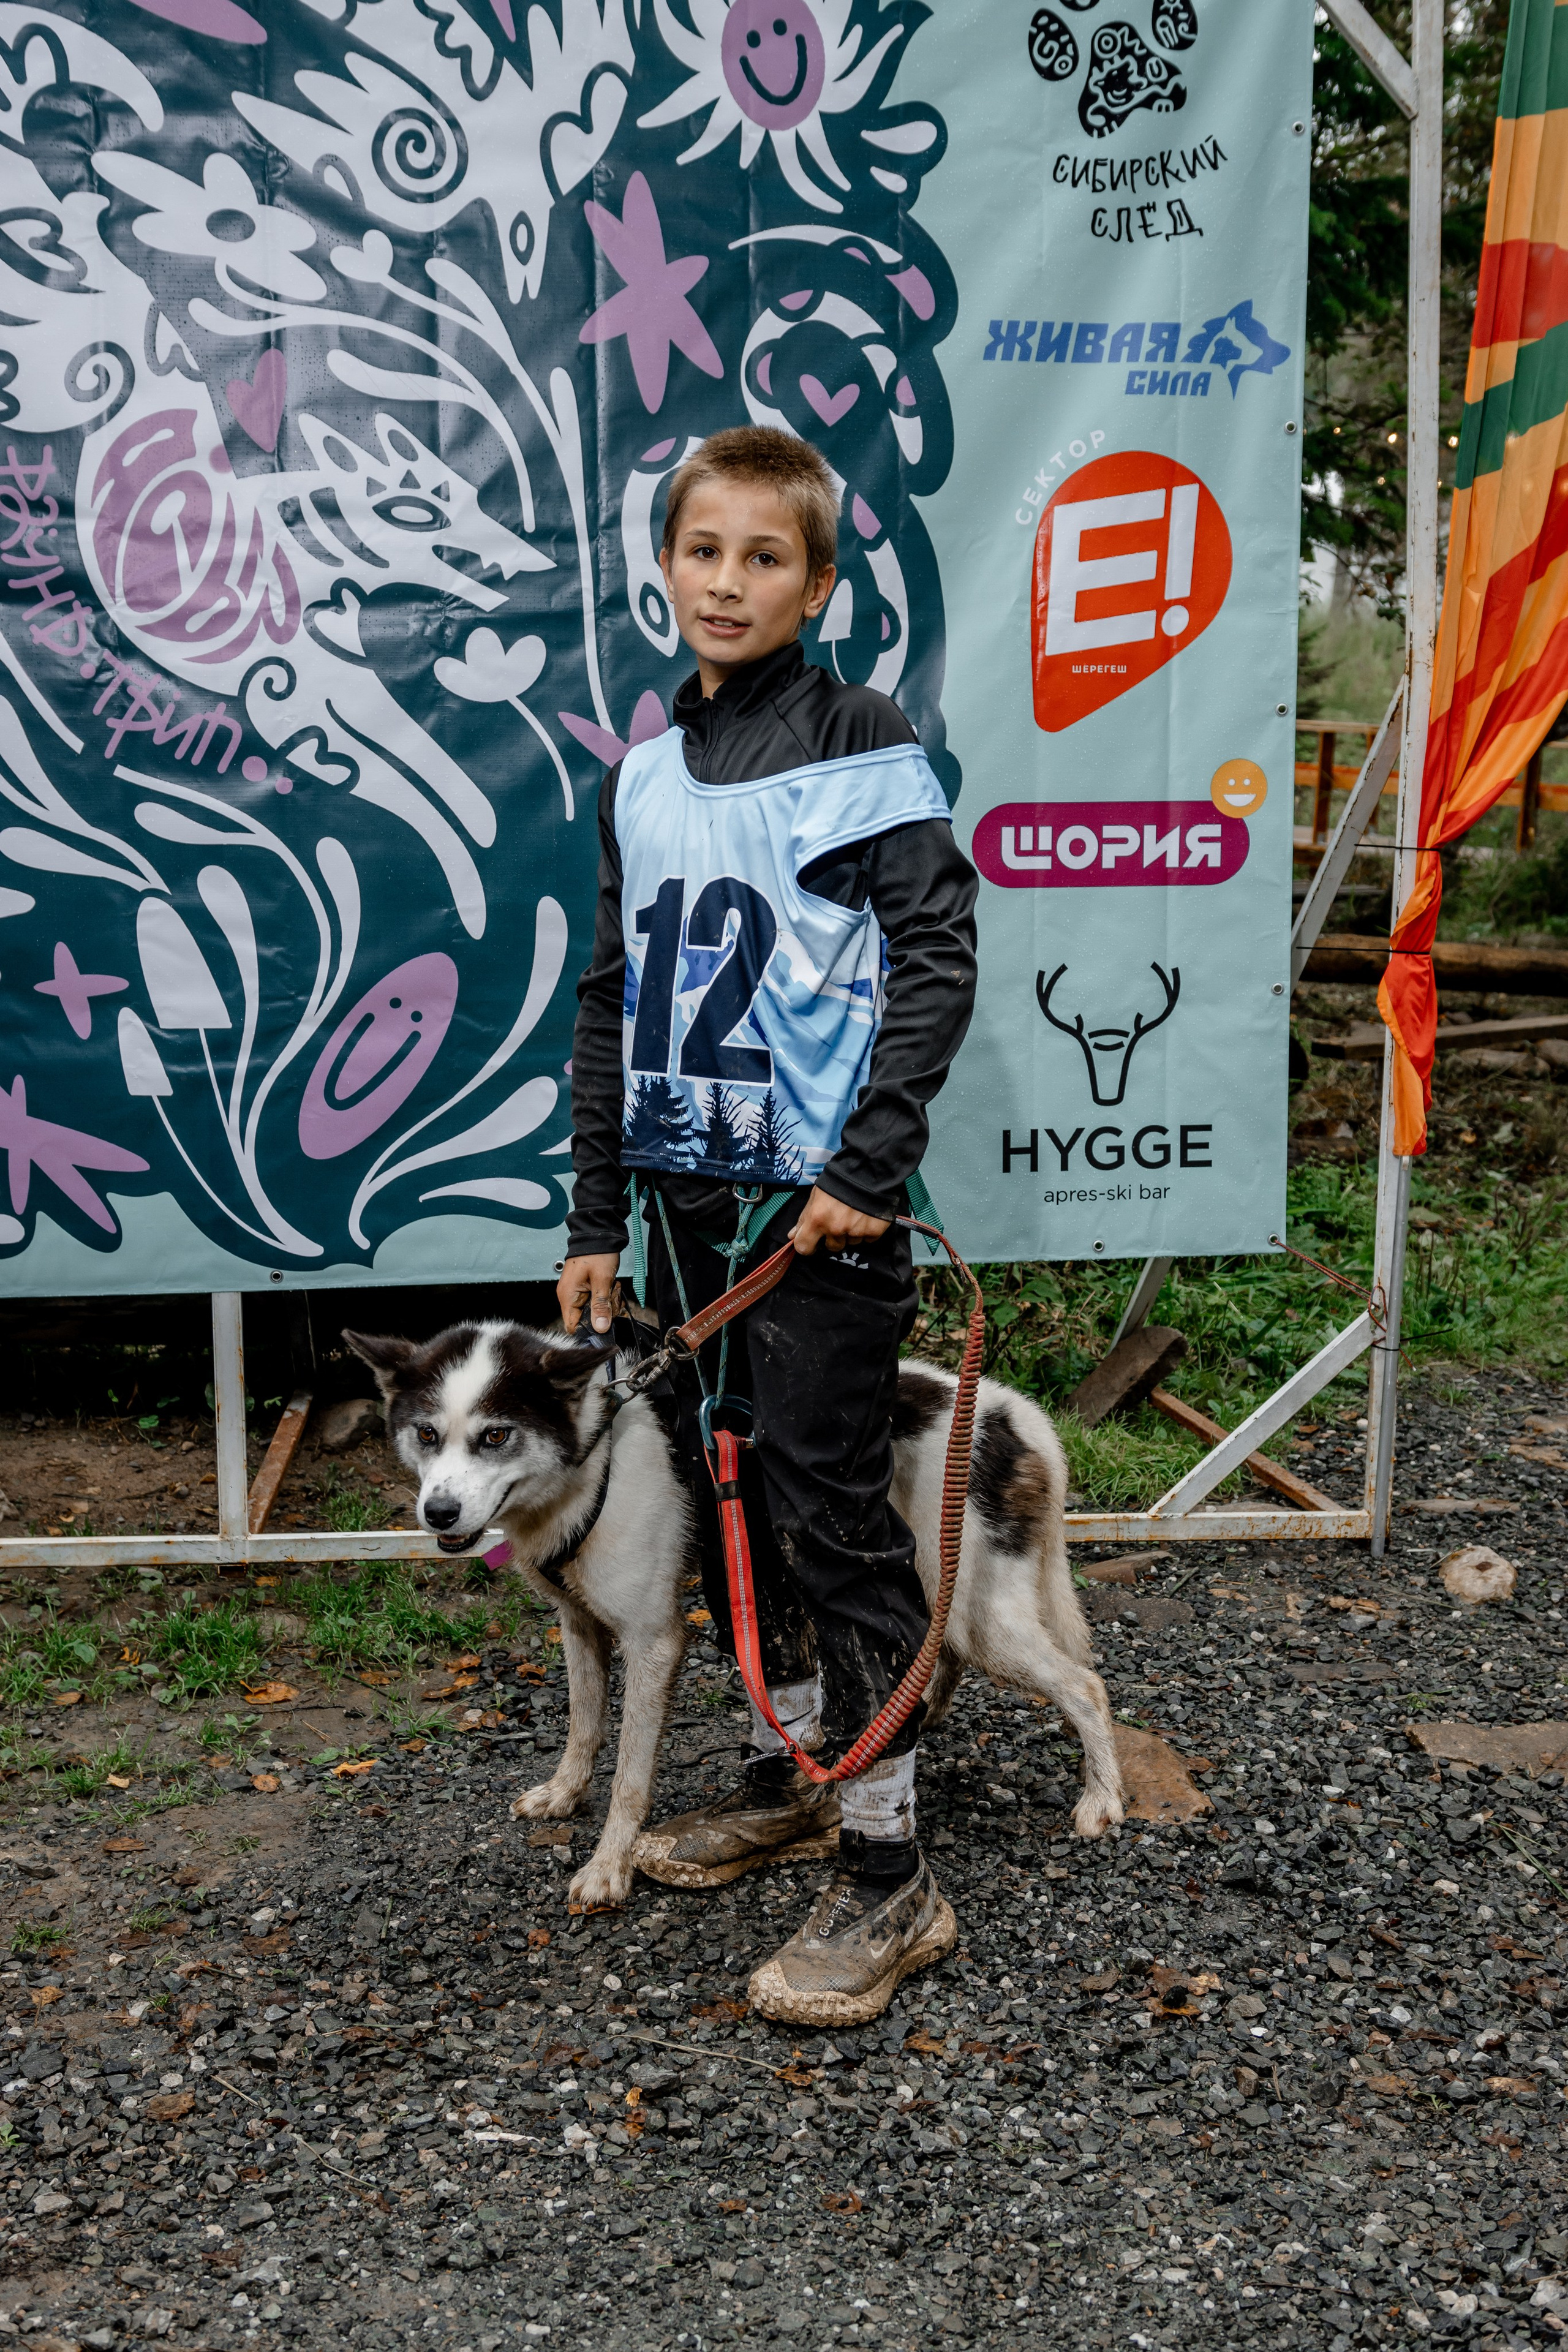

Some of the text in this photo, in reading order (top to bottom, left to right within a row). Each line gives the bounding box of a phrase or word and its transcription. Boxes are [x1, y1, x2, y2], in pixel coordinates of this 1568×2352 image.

[1052, 134, 1228, 194] СИБИРСКИЙ
[1091, 198, 1204, 243] СЛЁД
[982, 319, 1182, 363] ЖИВАЯ
[1125, 370, 1212, 396] СИЛА
[1015, 429, 1106, 525] СЕКТОР
[1072, 665, 1127, 673] ШЕРЕГЕШ
[1001, 824, 1222, 870] ШОРИЯ
[630, 873, 777, 1087] 12
[1002, 1124, 1213, 1174] HYGGE
[1044, 1184, 1170, 1204] apres-ski bar
